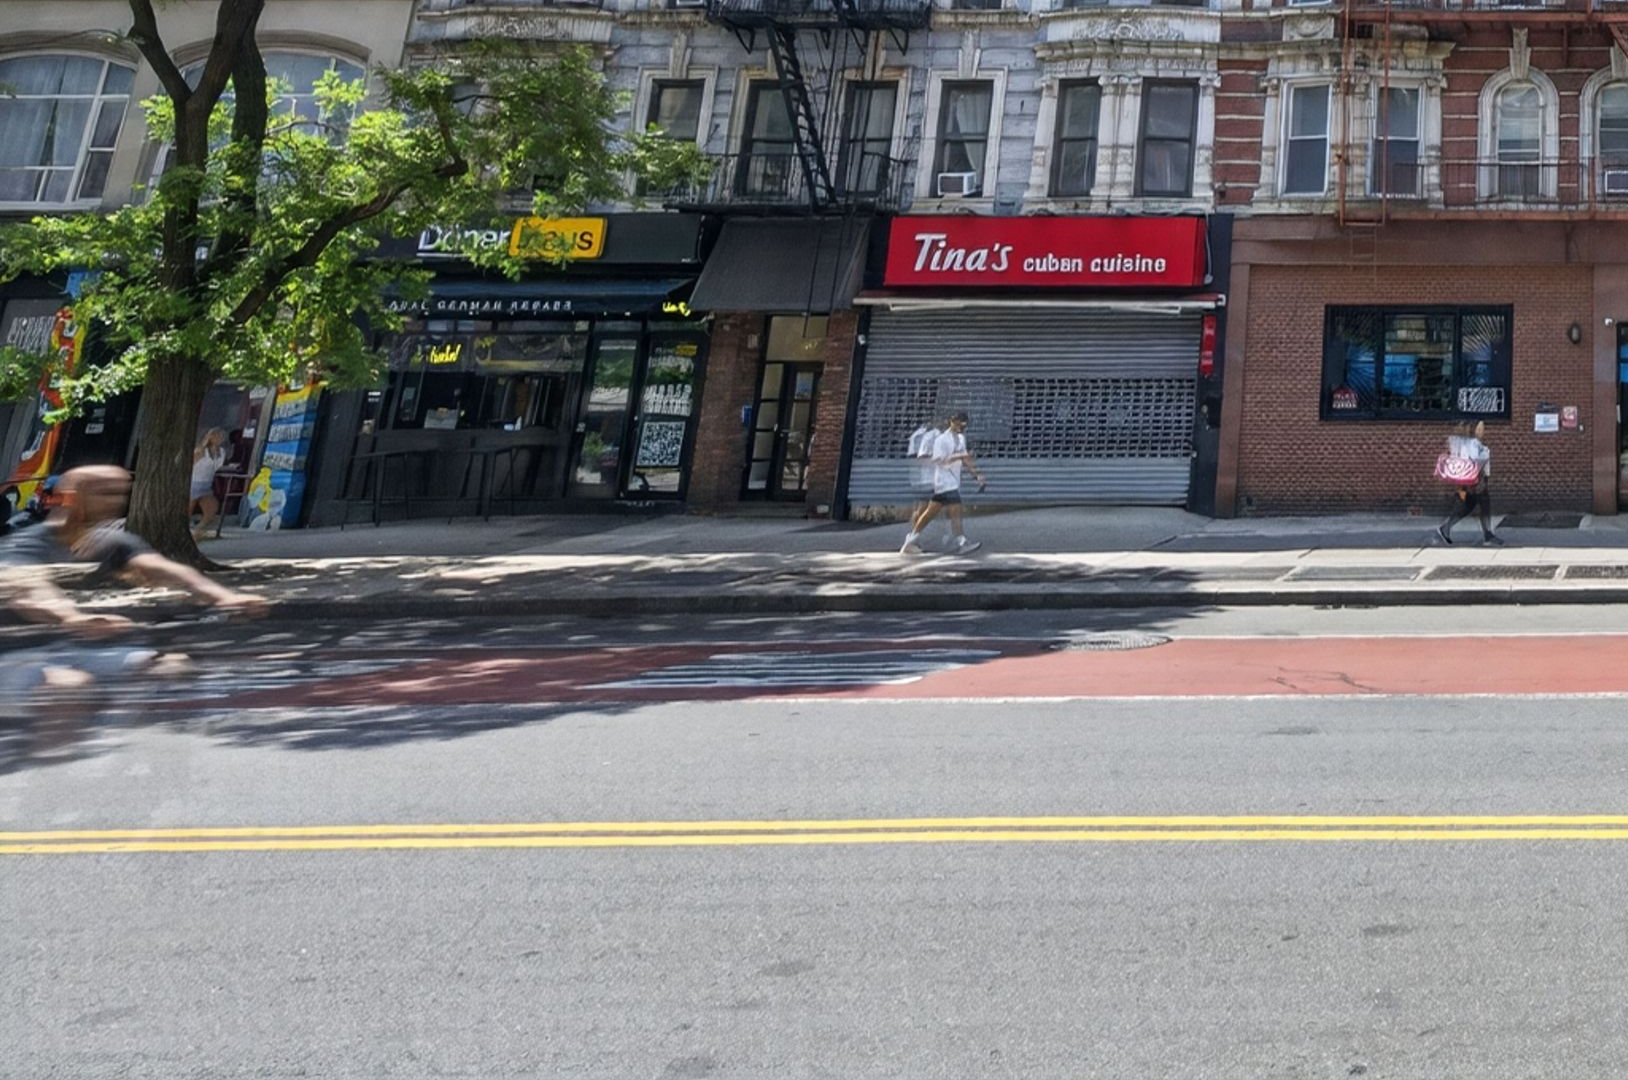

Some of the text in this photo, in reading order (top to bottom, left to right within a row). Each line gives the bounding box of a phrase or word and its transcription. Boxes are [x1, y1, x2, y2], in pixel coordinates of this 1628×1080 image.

[914, 233, 1166, 273] Tina's cuban cuisine
